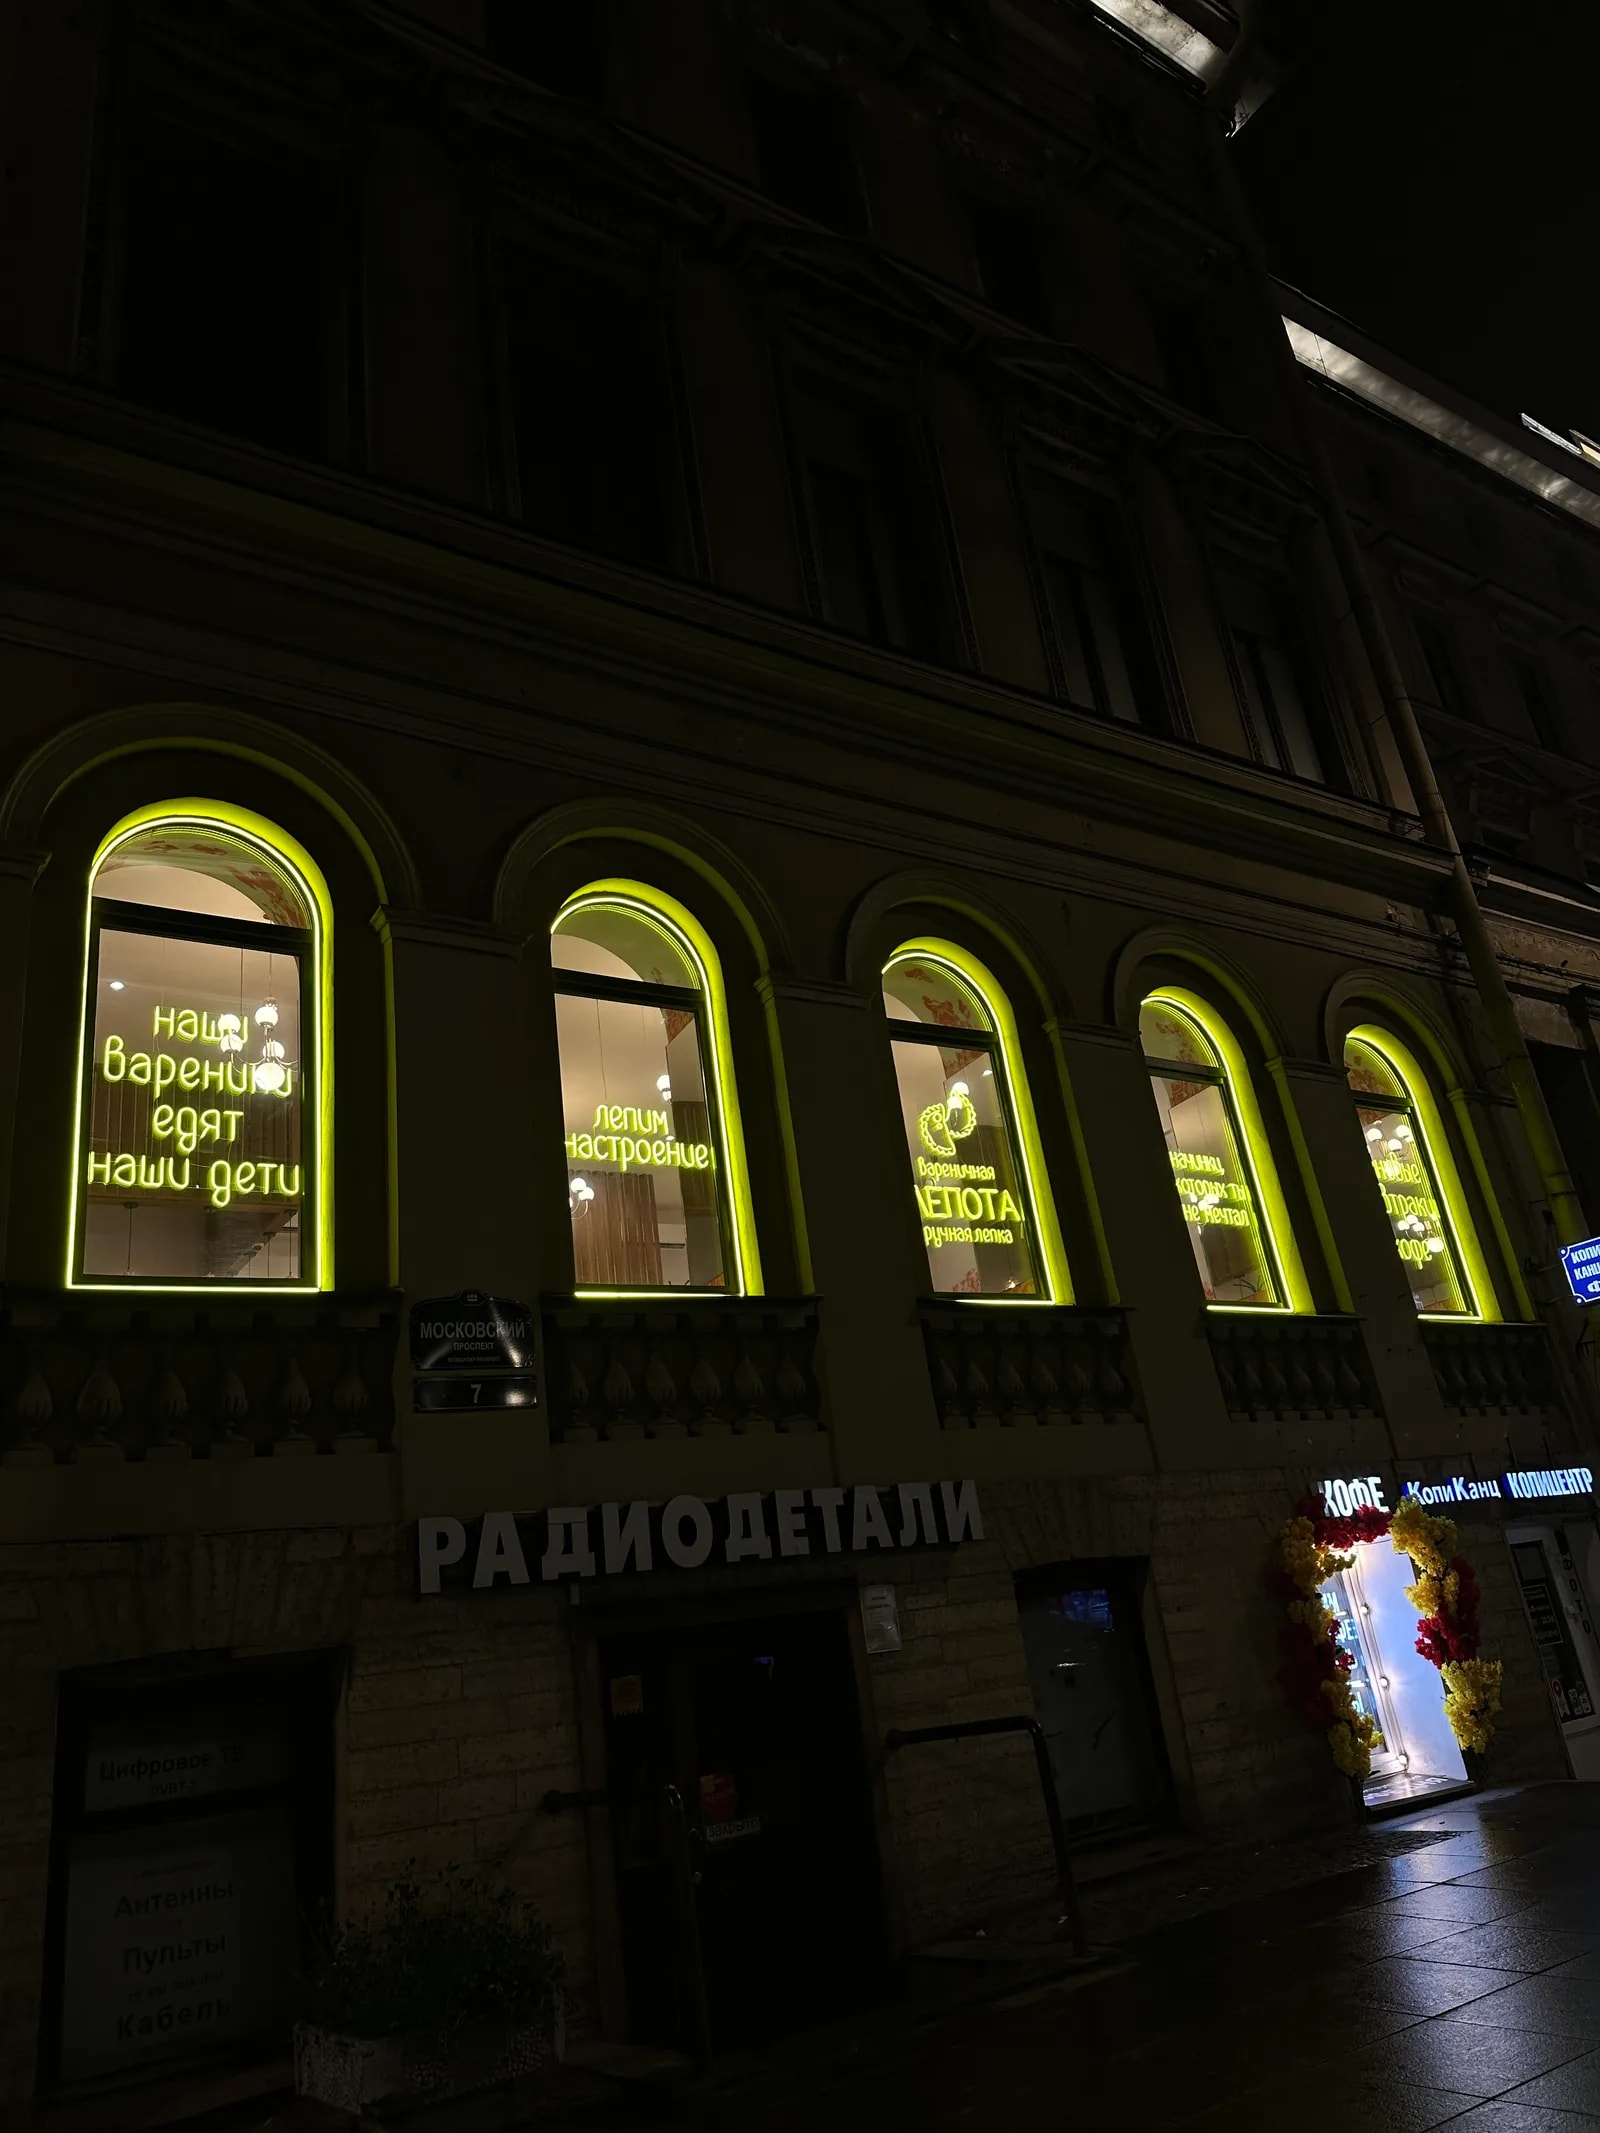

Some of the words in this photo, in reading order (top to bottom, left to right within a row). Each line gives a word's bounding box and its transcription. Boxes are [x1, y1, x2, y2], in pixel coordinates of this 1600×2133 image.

[153, 1104, 243, 1154] едят
[593, 1104, 669, 1135] лепим
[88, 1151, 190, 1190] наши
[210, 1160, 299, 1208] дети
[917, 1156, 995, 1181] вареничная
[923, 1225, 973, 1247] ручная
[974, 1227, 1013, 1244] лепка
[420, 1319, 525, 1339] МОСКОВСКИЙ
[453, 1341, 495, 1351] ПРОСПЕКТ
[470, 1383, 482, 1403] 7
[1318, 1476, 1389, 1517] КОФЕ
[1506, 1468, 1593, 1498] КОПИЦЕНТР
[418, 1479, 985, 1594] РАДИОДЕТАЛИ
[100, 1752, 212, 1782] Цифровое
[114, 1881, 233, 1920] Антенны
[122, 1935, 226, 1975] Пульты
[117, 1998, 231, 2041] Кабель
